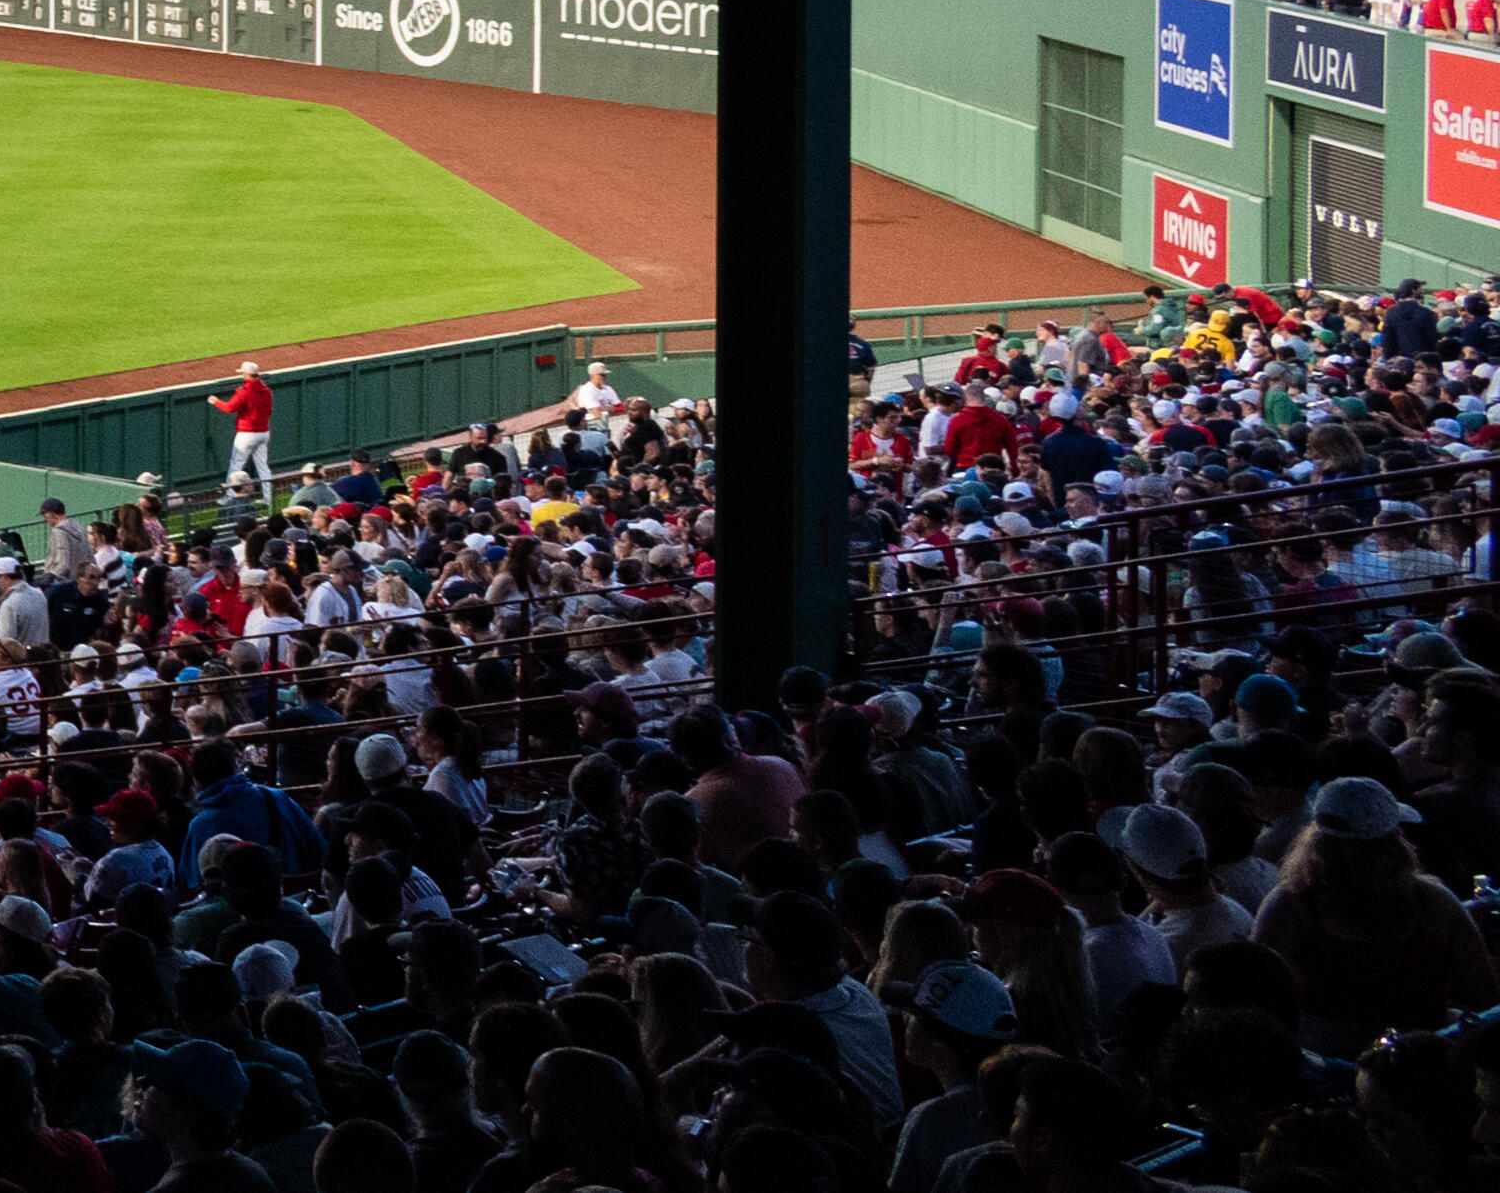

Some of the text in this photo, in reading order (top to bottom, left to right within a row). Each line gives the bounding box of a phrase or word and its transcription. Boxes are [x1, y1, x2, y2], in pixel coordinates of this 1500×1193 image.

[163, 6, 181, 22] PIT
[253, 0, 275, 15] MIL
[335, 3, 513, 47] Since 1866
[163, 17, 220, 43] PHI 6 5
[1160, 23, 1186, 62] city
[1160, 59, 1208, 95] cruises
[1432, 98, 1500, 150] Safeli
[1163, 209, 1217, 260] IRVING
[1197, 333, 1219, 349] 25
